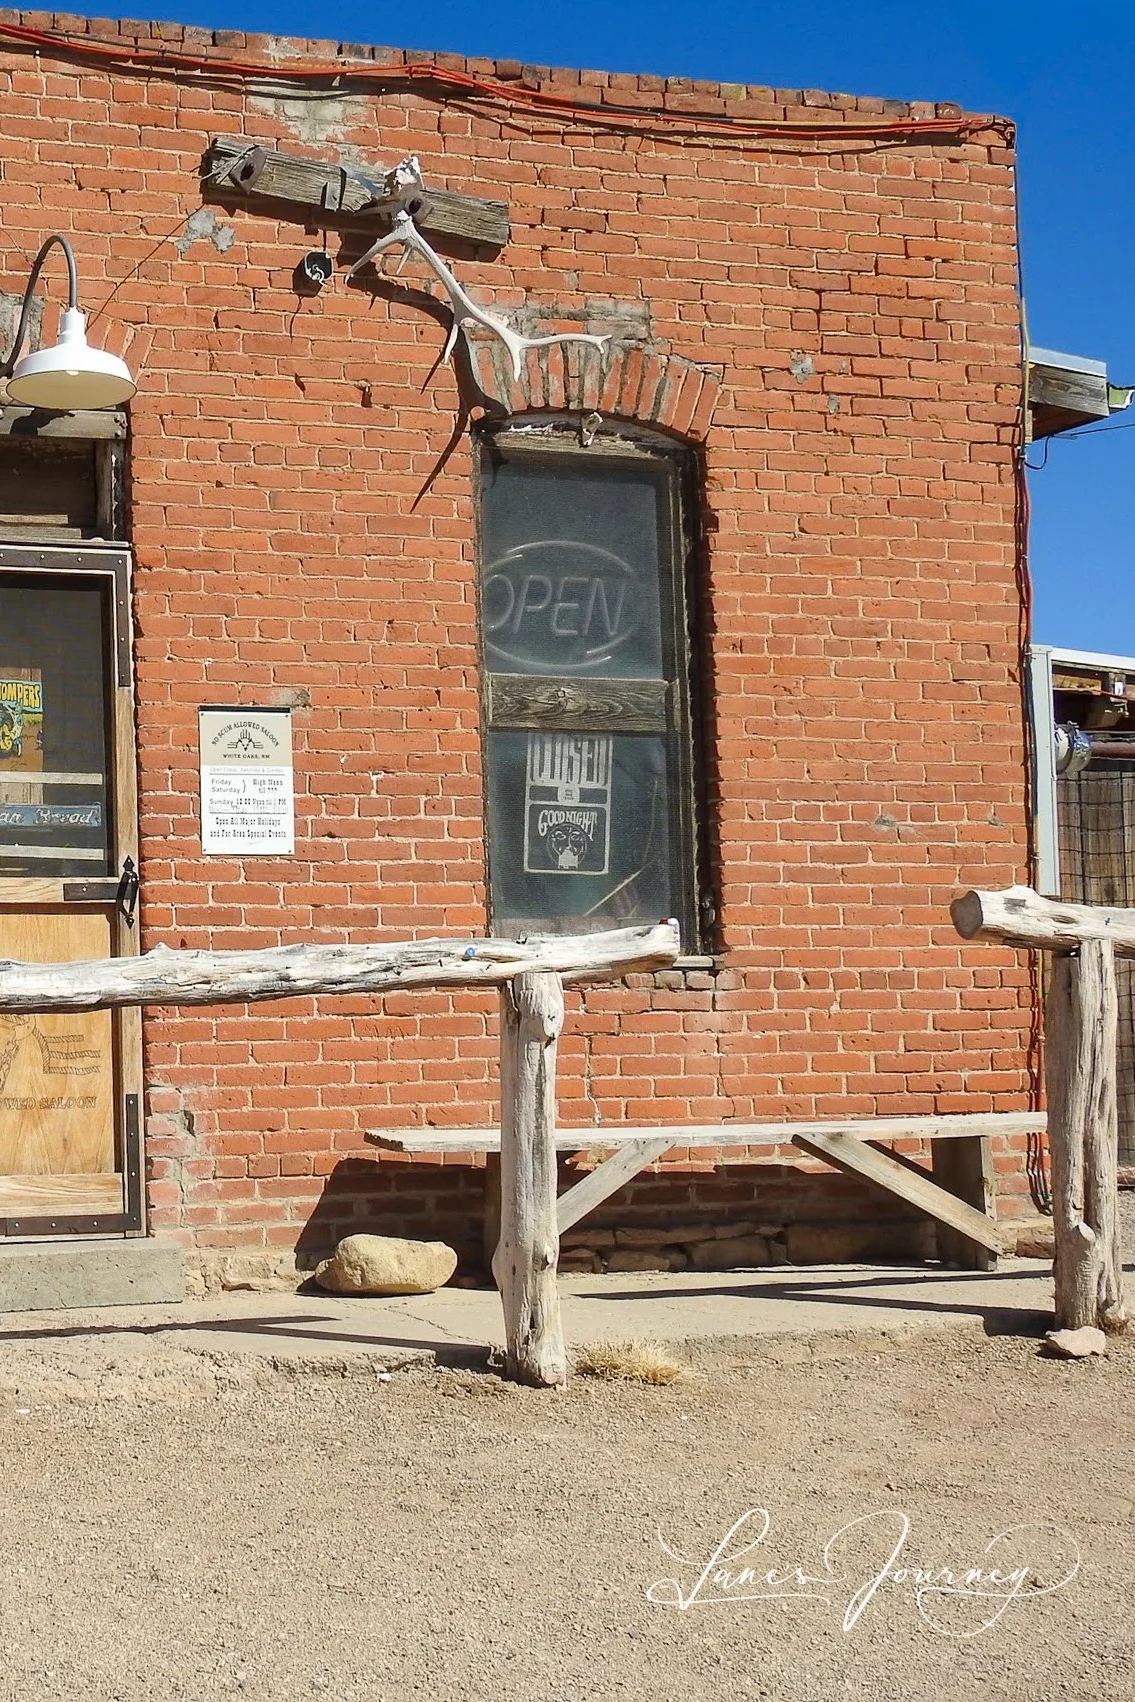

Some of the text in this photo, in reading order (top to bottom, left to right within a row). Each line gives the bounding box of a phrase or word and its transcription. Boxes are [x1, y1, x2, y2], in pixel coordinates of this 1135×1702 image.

[485, 574, 626, 637] OPEN
[218, 724, 233, 738] SCUM
[233, 721, 260, 730] ALLOWED
[261, 726, 280, 747] SALOON
[40, 1096, 98, 1109] SALOON
